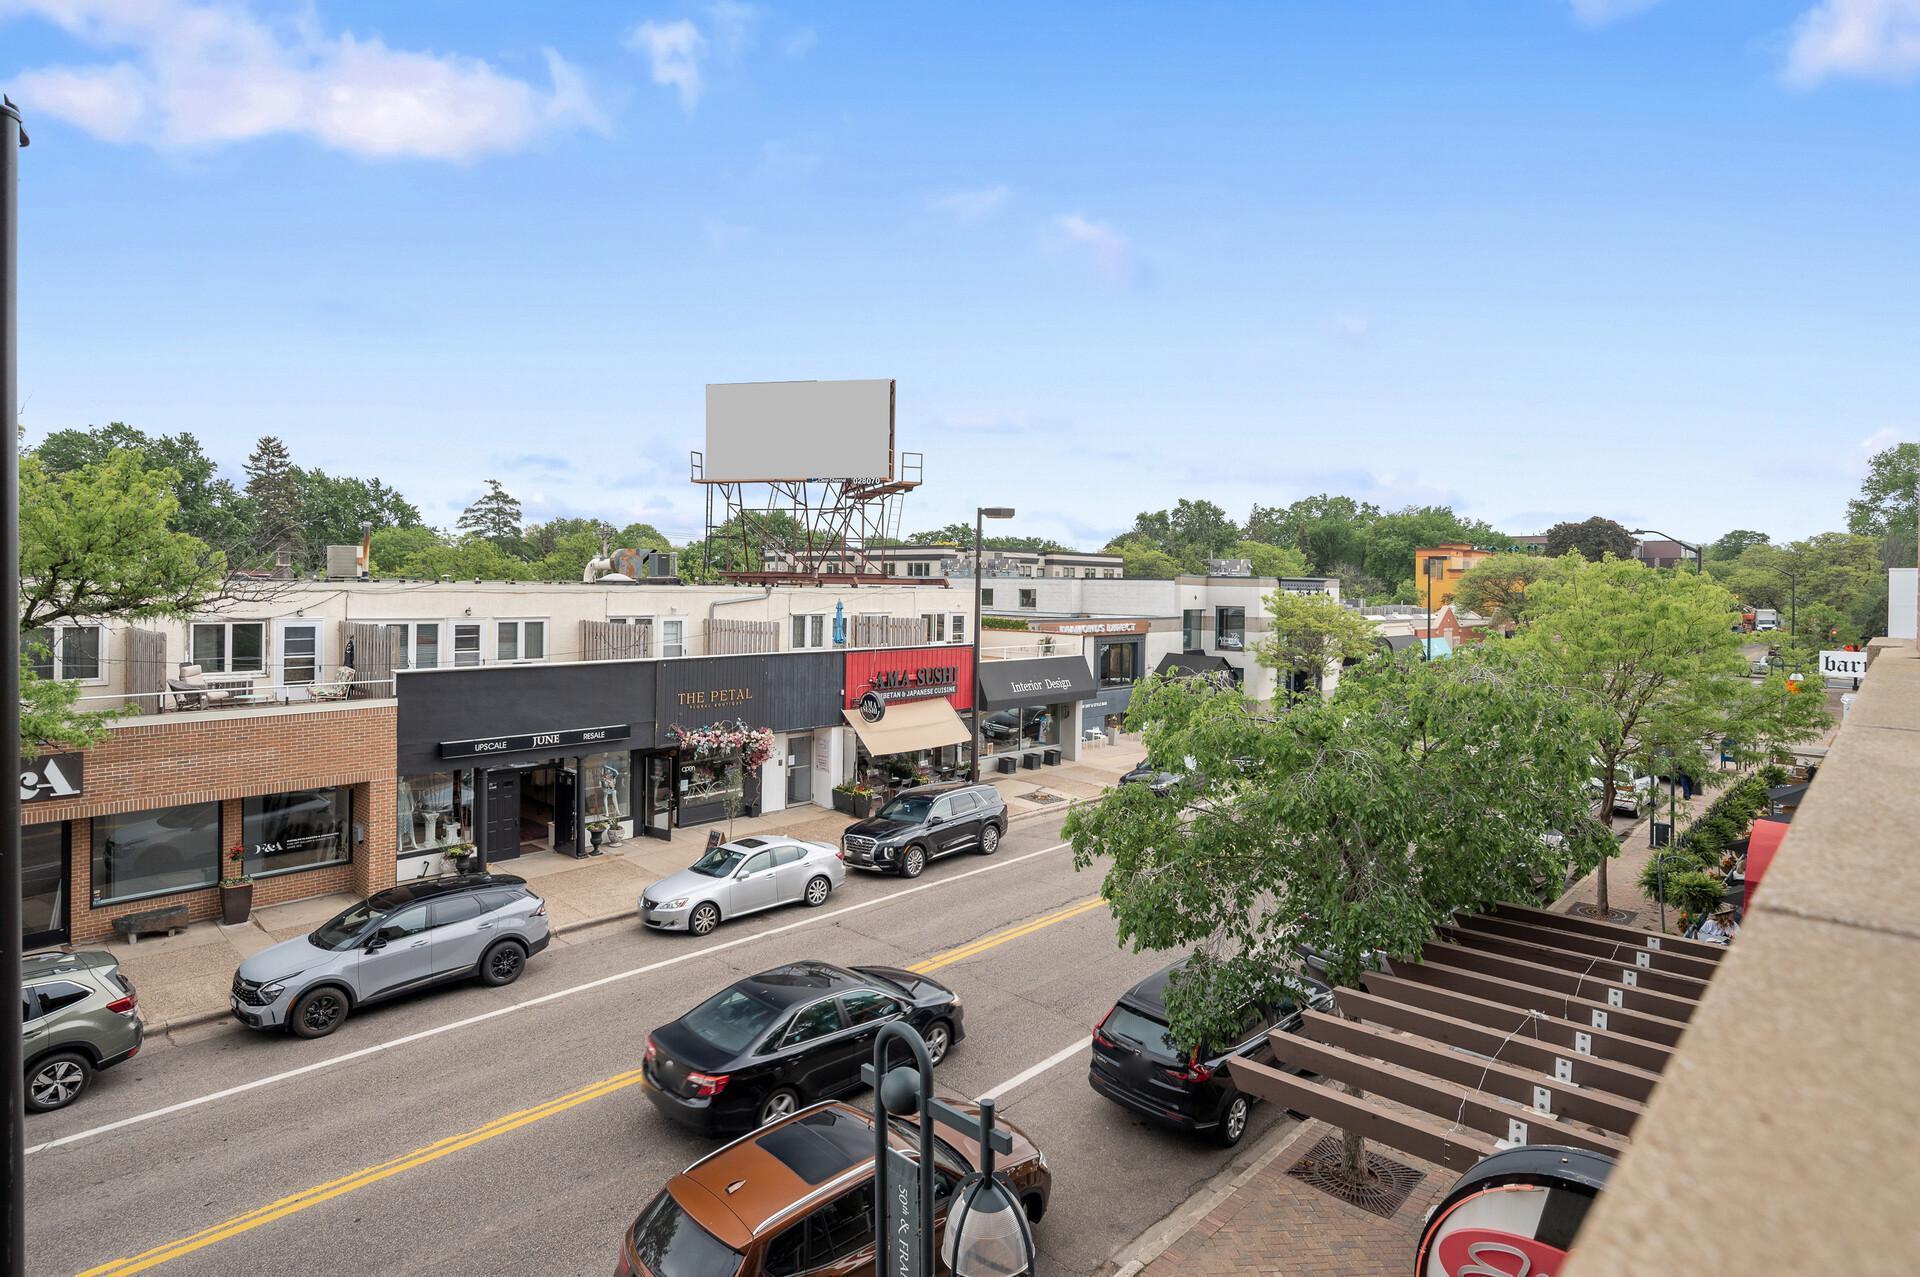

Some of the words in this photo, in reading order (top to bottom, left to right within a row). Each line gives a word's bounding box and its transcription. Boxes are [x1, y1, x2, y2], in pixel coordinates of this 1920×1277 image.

[875, 669, 911, 688] AMA
[917, 666, 958, 686] SUSHI
[1011, 680, 1042, 692] Interior
[1045, 677, 1072, 690] Design
[677, 691, 705, 704] THE
[711, 688, 753, 702] PETAL
[880, 691, 900, 699] IBETAN
[906, 689, 933, 697] JAPANESE
[934, 686, 956, 694] CUISINE
[474, 741, 507, 751] UPSCALE
[532, 734, 560, 748] JUNE
[583, 731, 605, 740] RESALE
[898, 1218, 910, 1235] &
